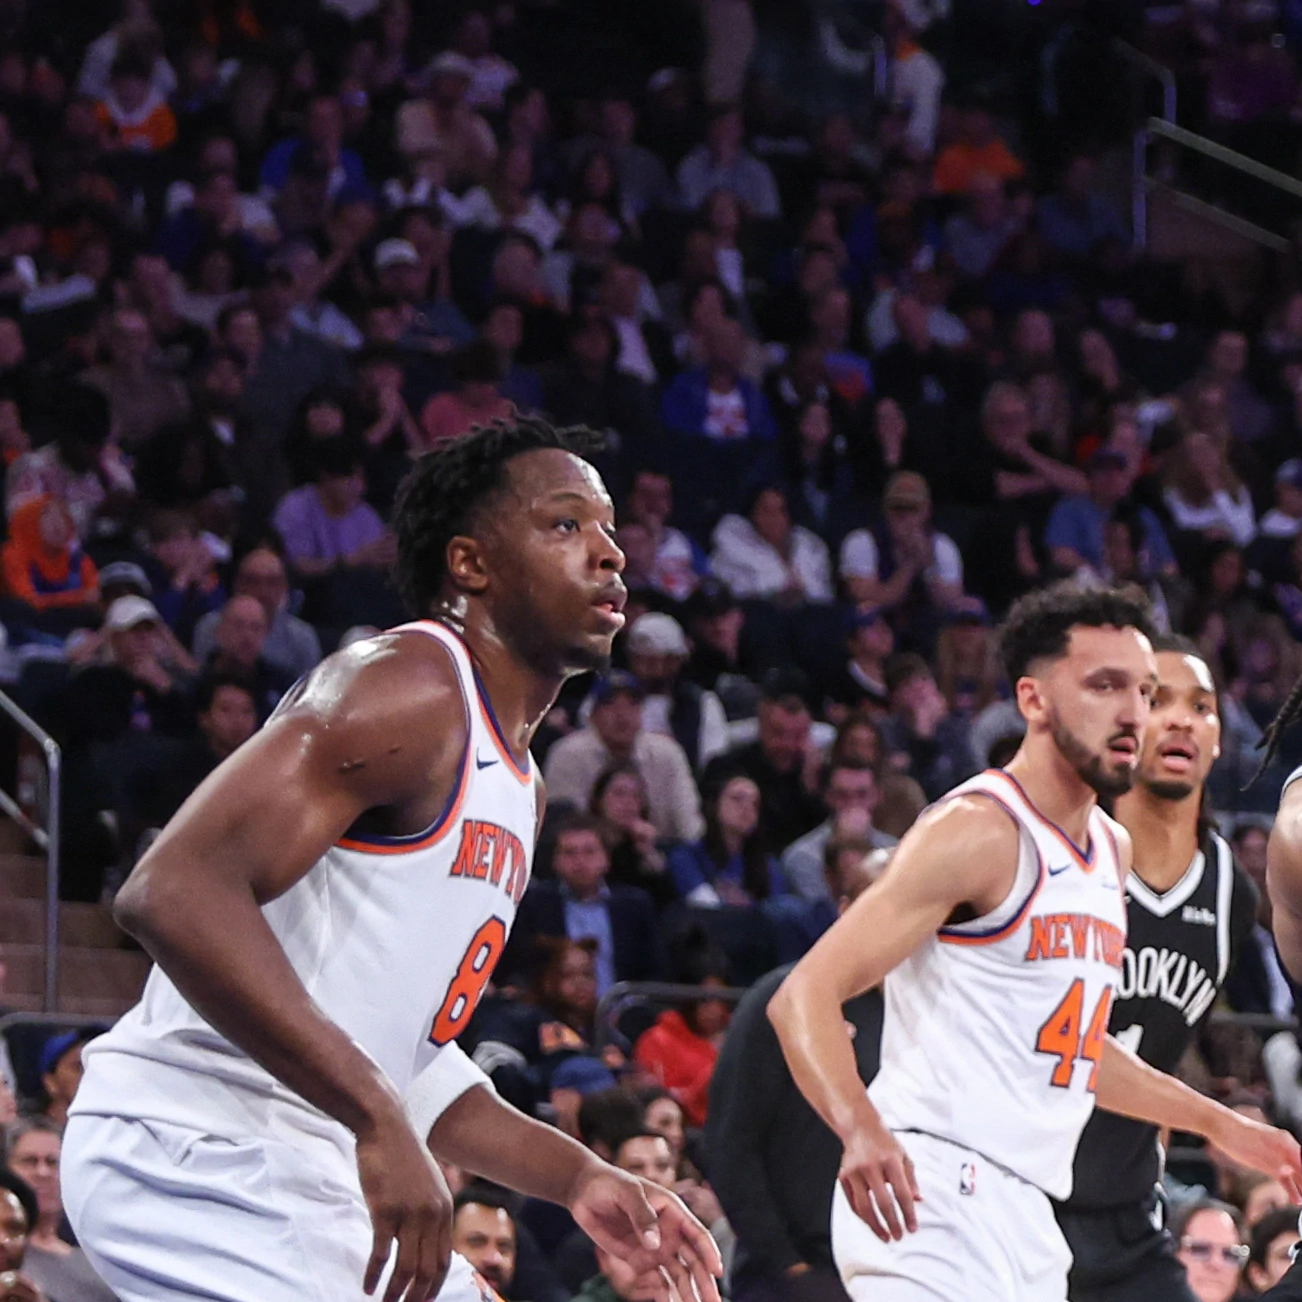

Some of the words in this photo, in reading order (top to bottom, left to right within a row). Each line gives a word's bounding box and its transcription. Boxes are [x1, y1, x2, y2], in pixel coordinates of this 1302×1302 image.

[427, 914, 506, 1048] 8
[1025, 913, 1091, 962] NEW
[1113, 946, 1216, 1027] OOKLYN
[1034, 977, 1113, 1095] 44
